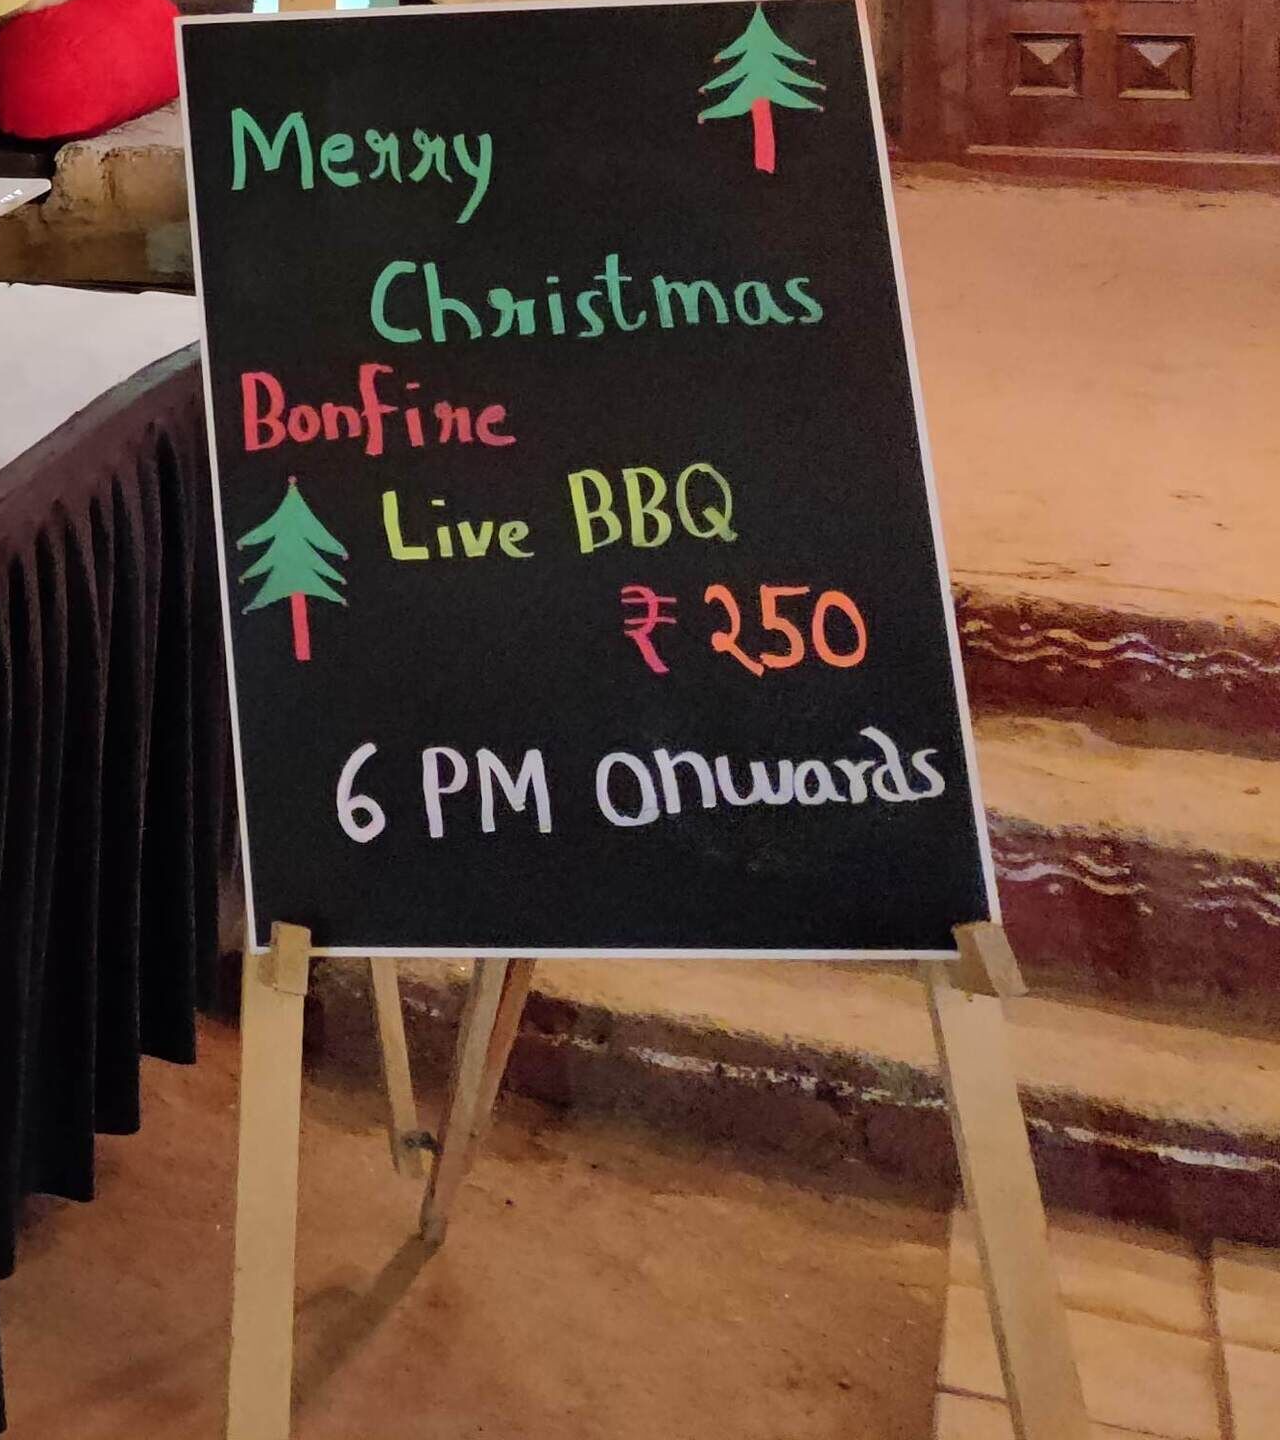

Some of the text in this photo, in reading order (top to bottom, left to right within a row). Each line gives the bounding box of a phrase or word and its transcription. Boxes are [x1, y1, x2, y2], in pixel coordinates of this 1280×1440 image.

[232, 108, 492, 223] Merry
[371, 254, 823, 342] Christmas
[242, 364, 516, 456] Bonfire
[383, 463, 737, 560] Live BBQ
[705, 584, 866, 676] 250
[337, 726, 945, 843] 6 PM Onwards
